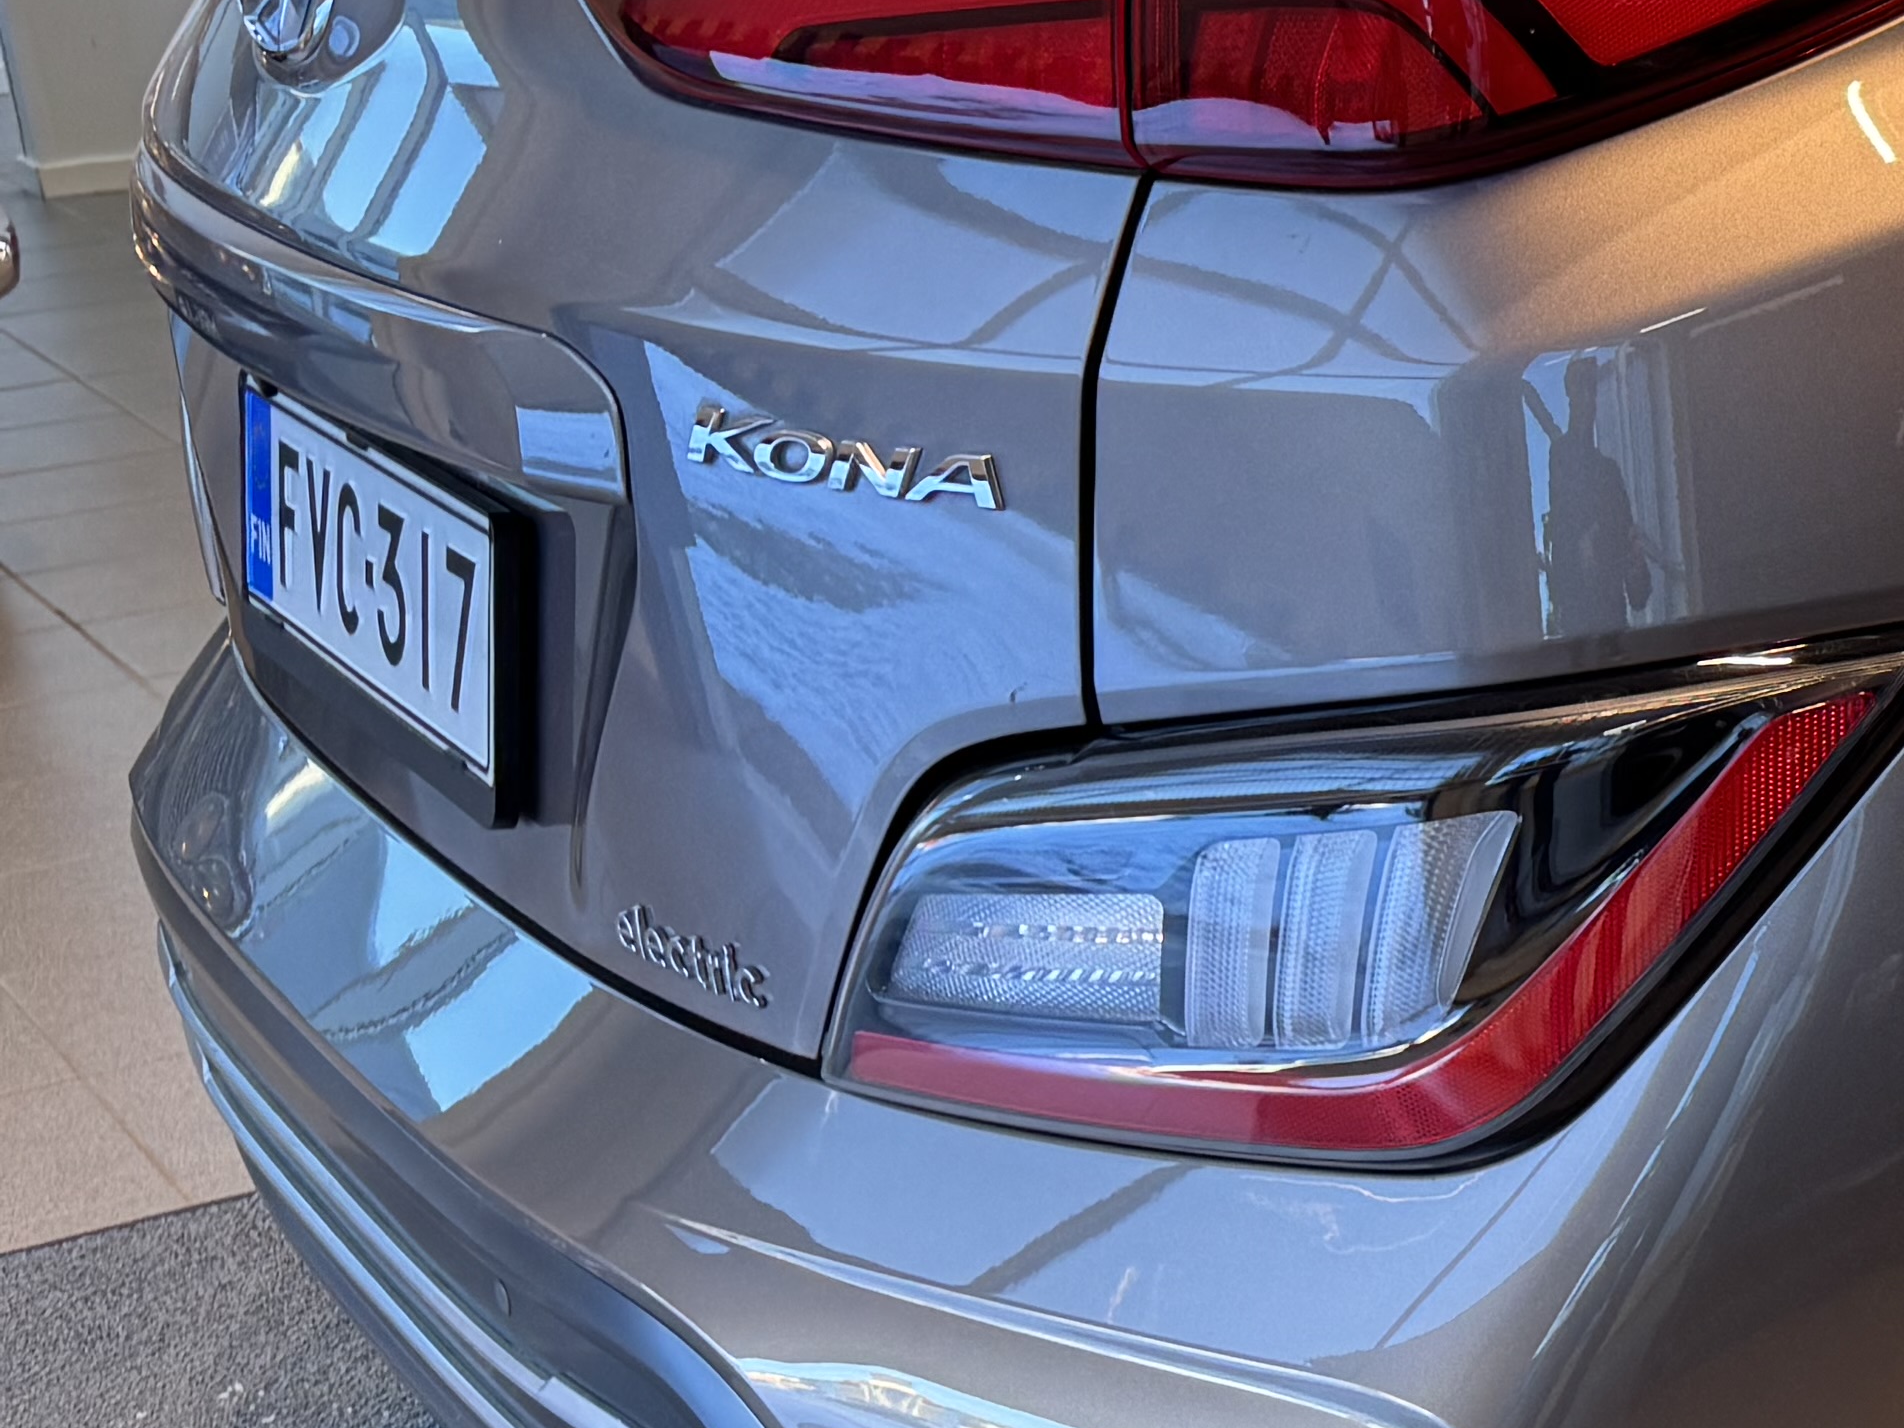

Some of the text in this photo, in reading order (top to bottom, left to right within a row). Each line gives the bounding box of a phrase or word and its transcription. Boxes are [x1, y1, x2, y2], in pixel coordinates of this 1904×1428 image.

[687, 404, 1005, 511] KONA
[250, 438, 477, 713] FIN FVC-317
[617, 904, 770, 1009] electric
